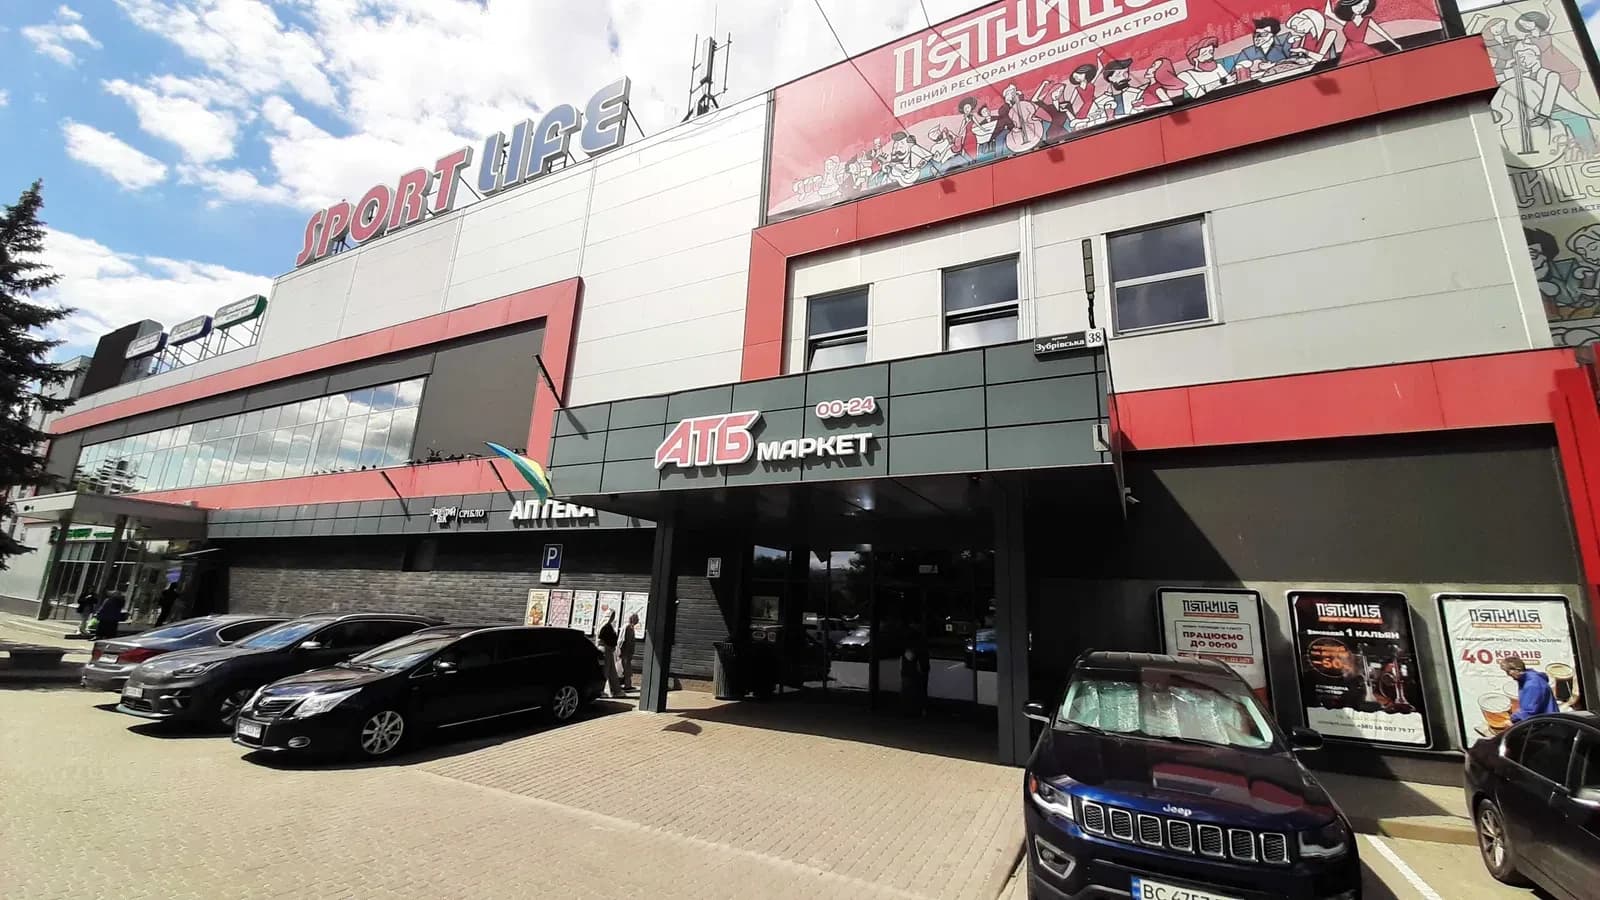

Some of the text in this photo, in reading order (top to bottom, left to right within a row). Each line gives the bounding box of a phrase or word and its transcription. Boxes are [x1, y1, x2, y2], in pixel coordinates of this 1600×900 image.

[894, 0, 1152, 94] П'ЯТНИЦ
[899, 6, 1180, 110] ПИВНИЙ РЕСТОРАН ХОРОШОГО НАСТРОЮ
[295, 75, 632, 268] SPORT LIFE
[1035, 331, 1102, 352] Зубрівська 38
[815, 396, 876, 419] 00-24
[654, 410, 873, 470] АТБ МАРКЕТ
[508, 499, 595, 520] АПТЕКА
[1190, 640, 1238, 649] ДО 00:00
[1355, 630, 1400, 639] КАЛЬЯН
[1461, 648, 1542, 665] 40 КРАНІВ
[1162, 803, 1193, 817] Jeep
